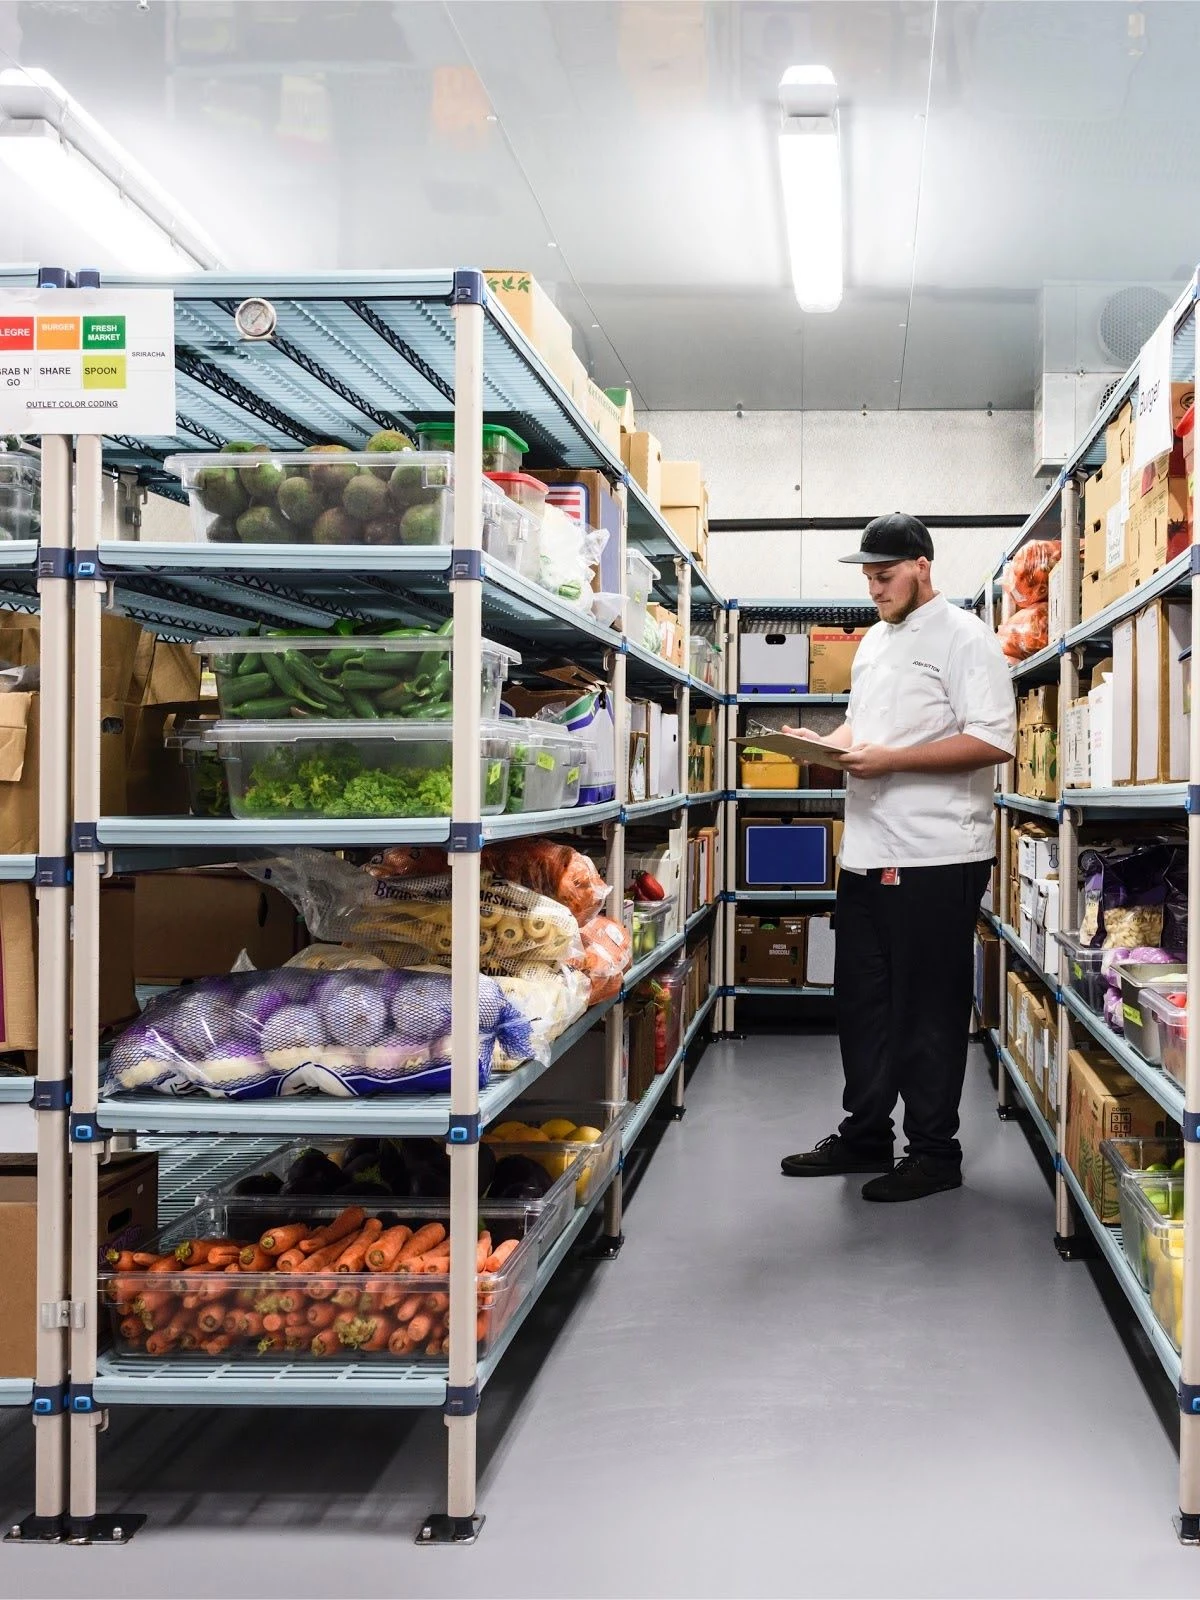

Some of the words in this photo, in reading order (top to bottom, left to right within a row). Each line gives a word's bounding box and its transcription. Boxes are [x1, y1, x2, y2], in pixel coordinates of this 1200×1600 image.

[42, 323, 74, 331] BURGER
[0, 367, 20, 375] RAB
[40, 367, 71, 375] SHARE
[85, 367, 117, 375] SPOON
[1140, 380, 1160, 416] Burger
